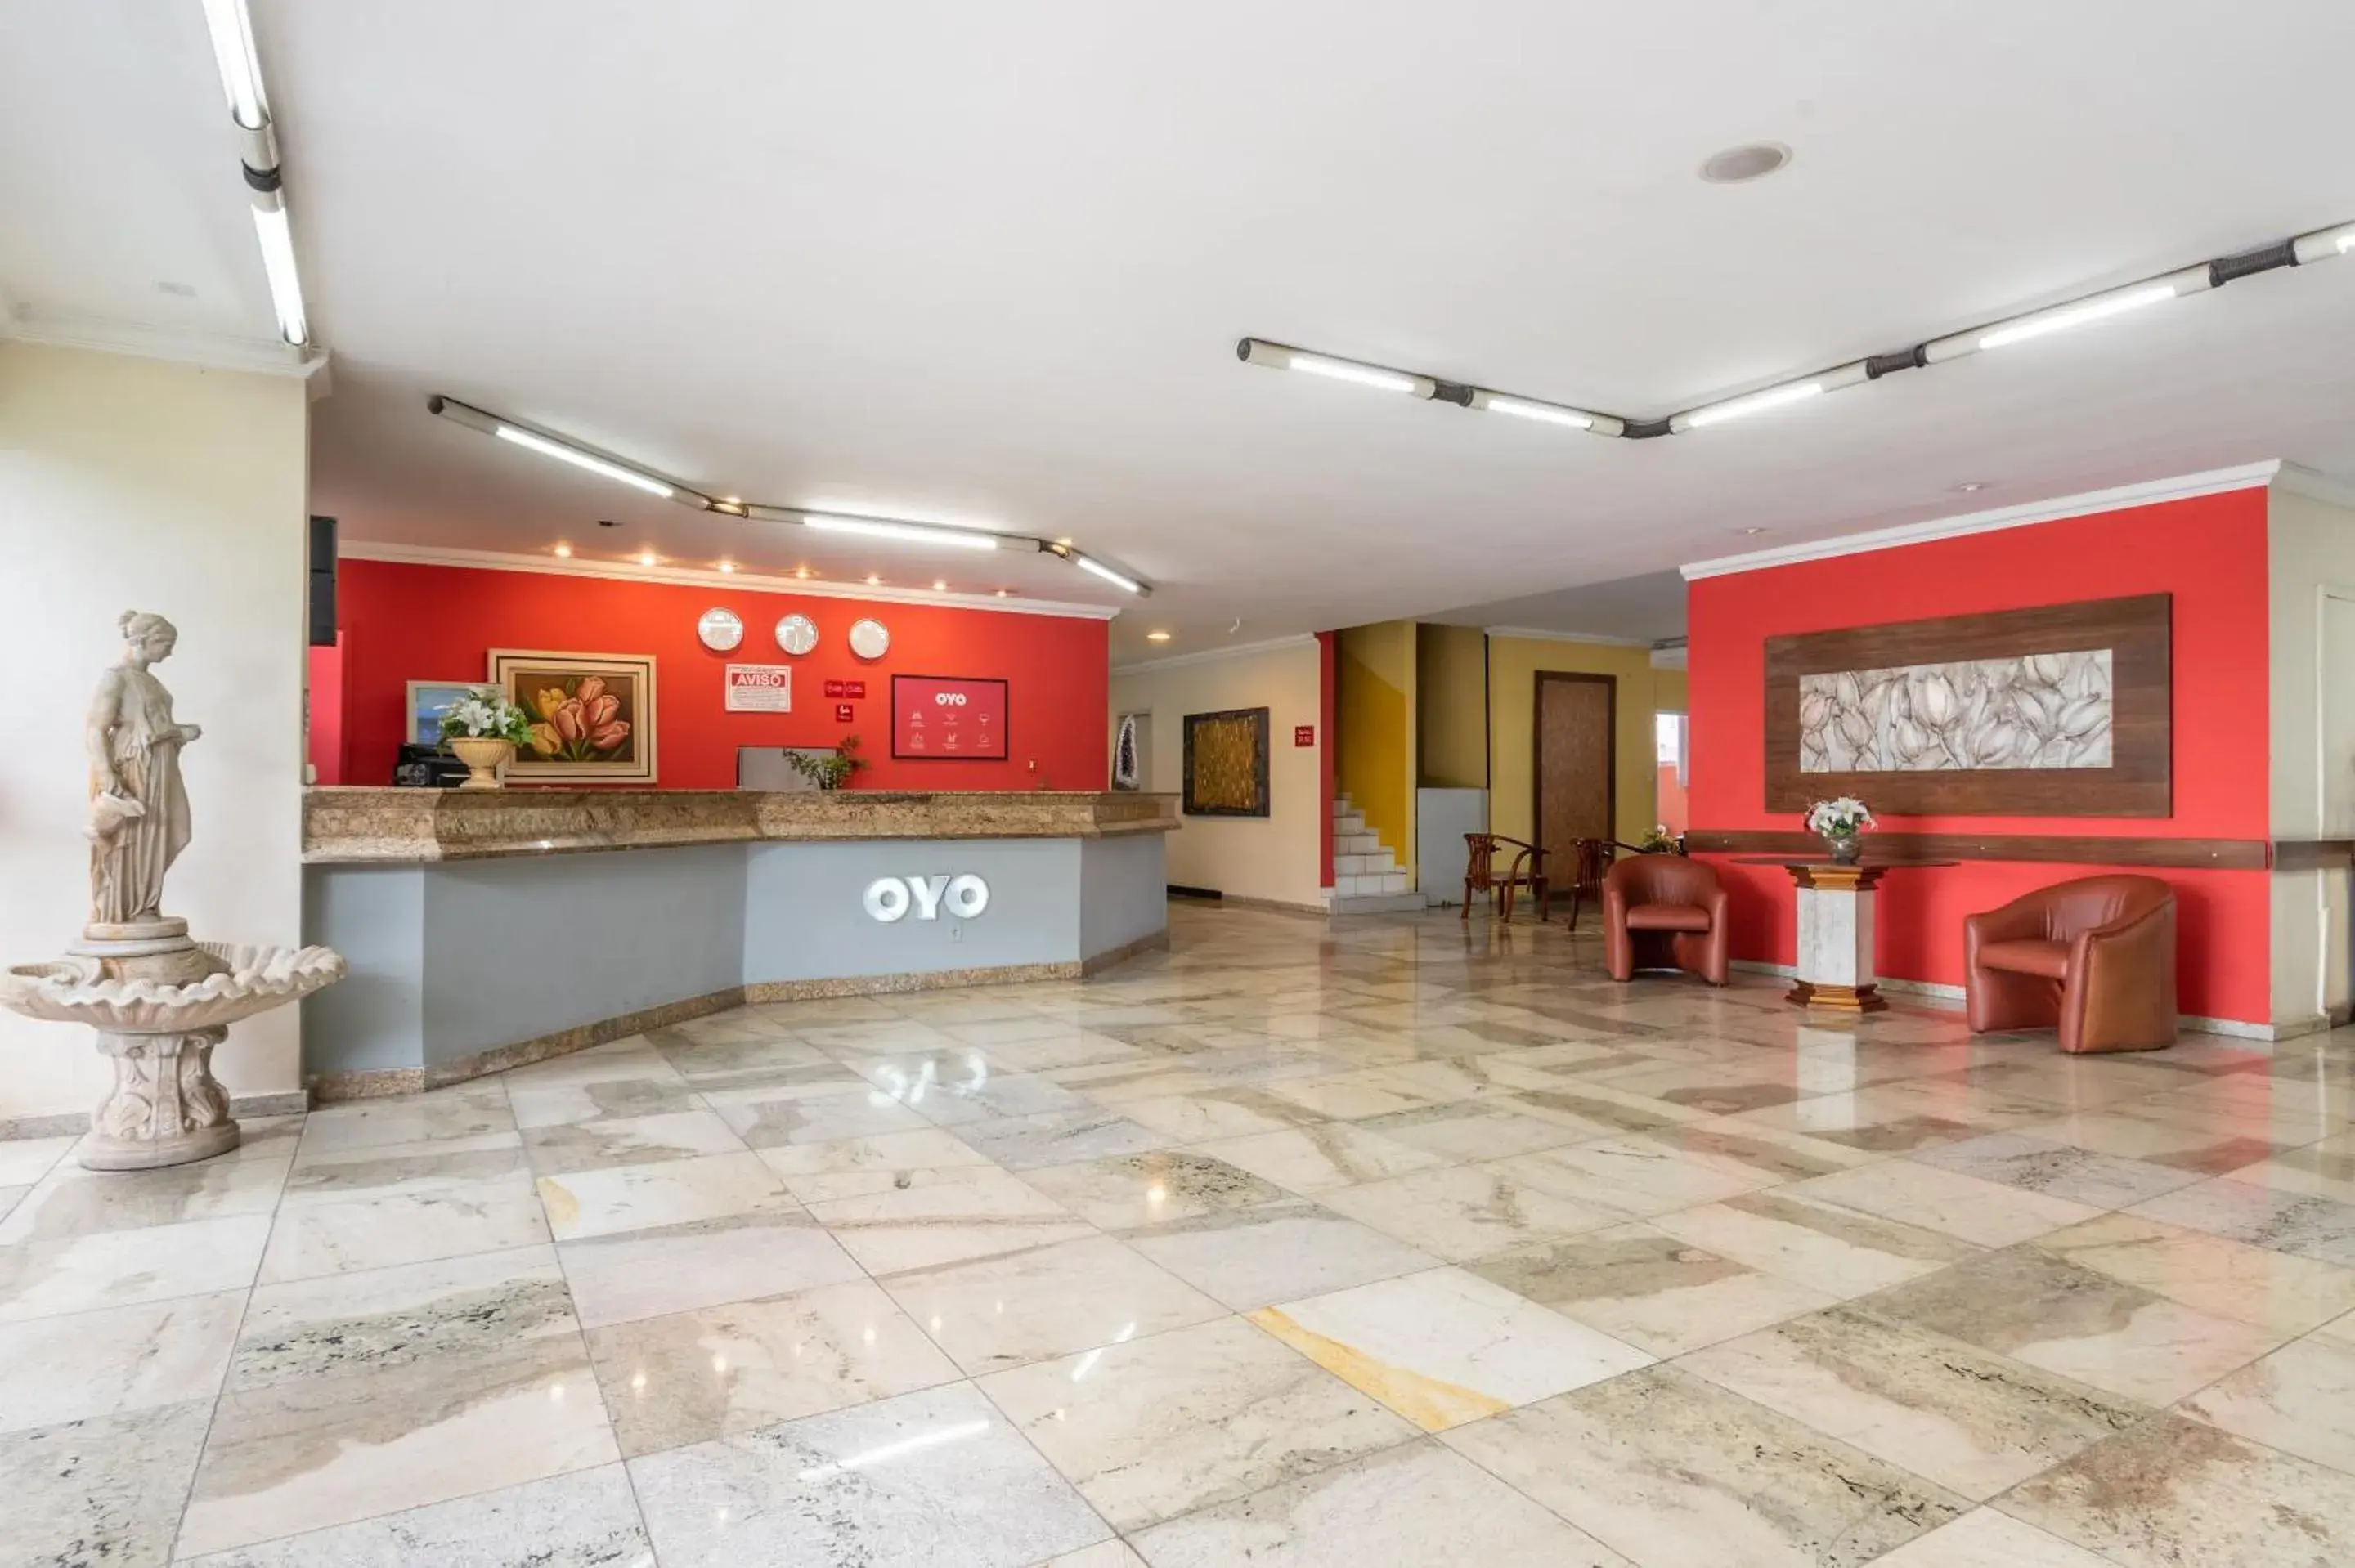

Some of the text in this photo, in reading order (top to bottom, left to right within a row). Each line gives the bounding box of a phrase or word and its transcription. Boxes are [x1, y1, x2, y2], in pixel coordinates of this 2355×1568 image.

[737, 674, 782, 687] AVISO
[935, 692, 967, 706] OYO
[863, 874, 989, 922] OYO
